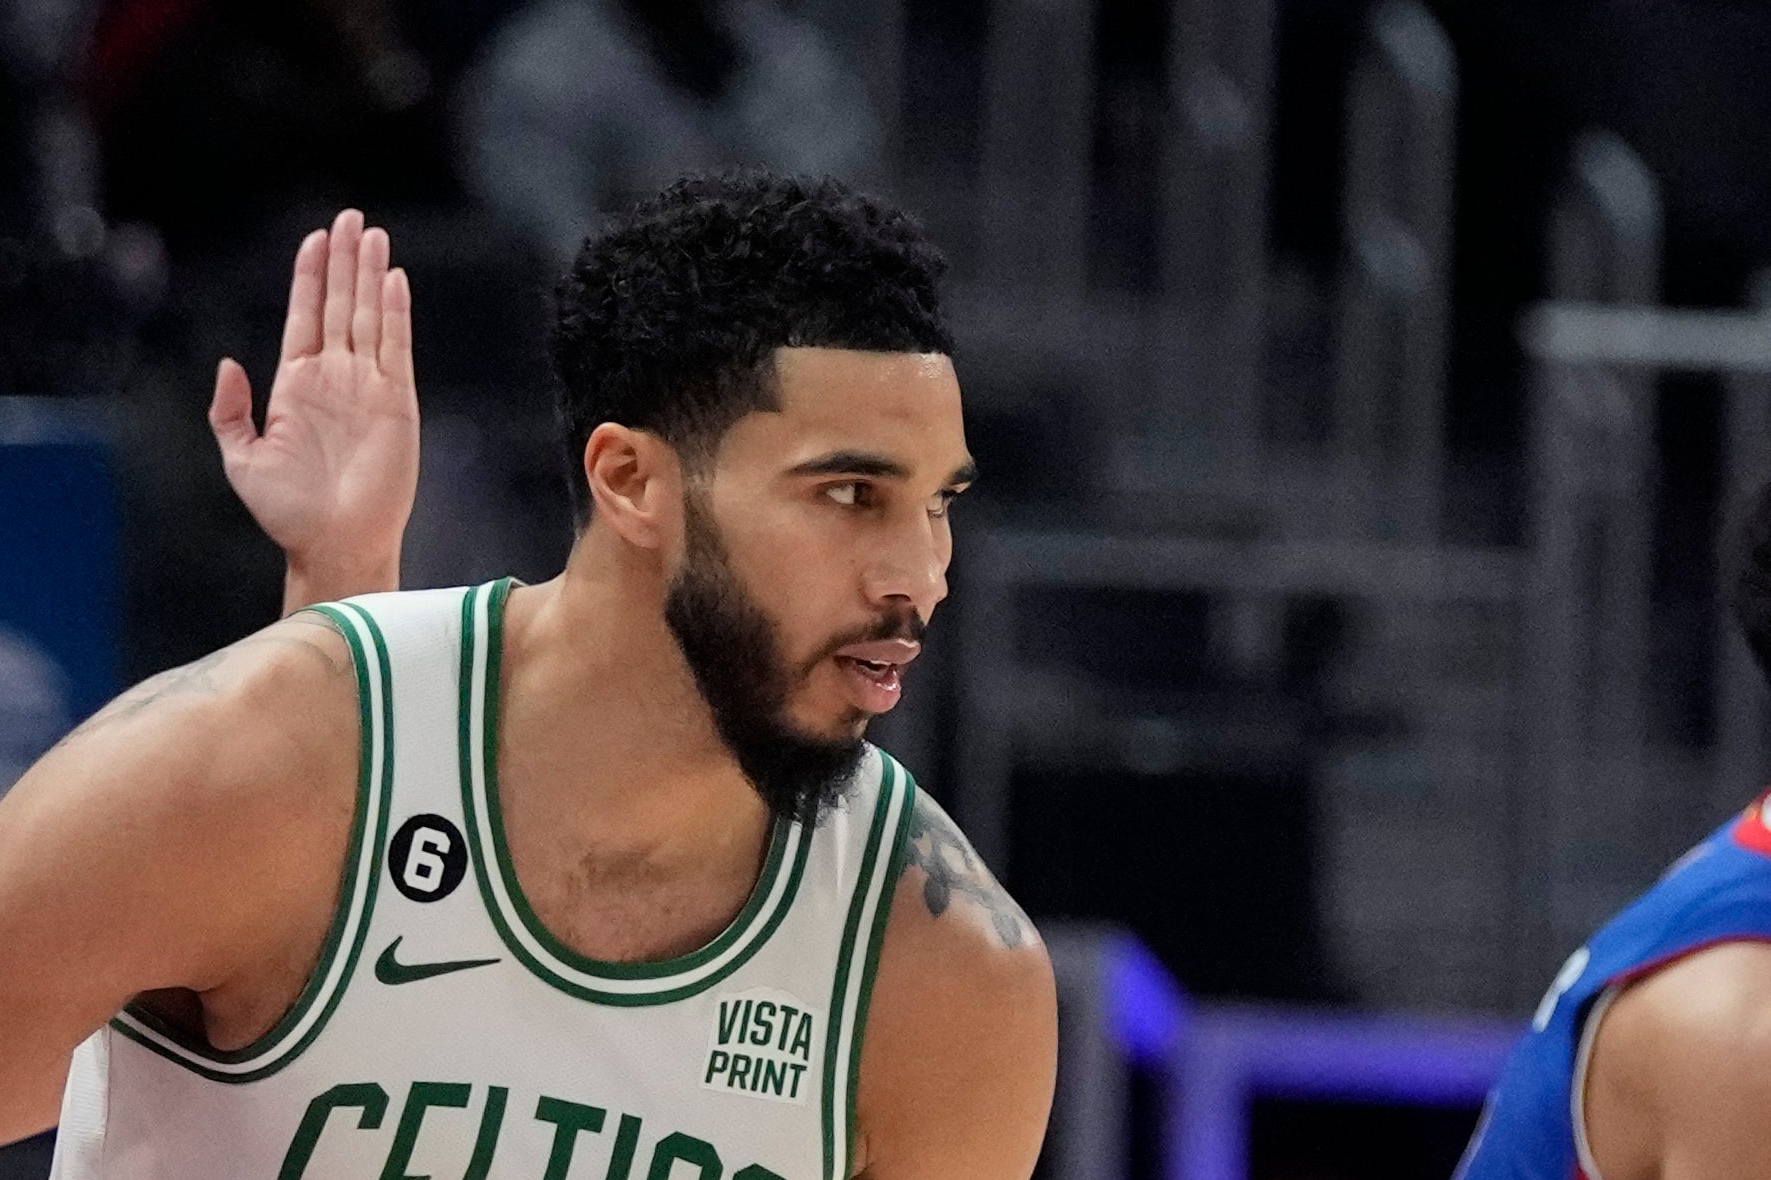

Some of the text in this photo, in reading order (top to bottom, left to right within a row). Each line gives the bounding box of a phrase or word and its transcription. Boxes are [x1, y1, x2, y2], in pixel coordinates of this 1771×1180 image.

[403, 826, 451, 893] 6
[718, 1000, 813, 1062] VISTA
[704, 1050, 807, 1098] PRINT
